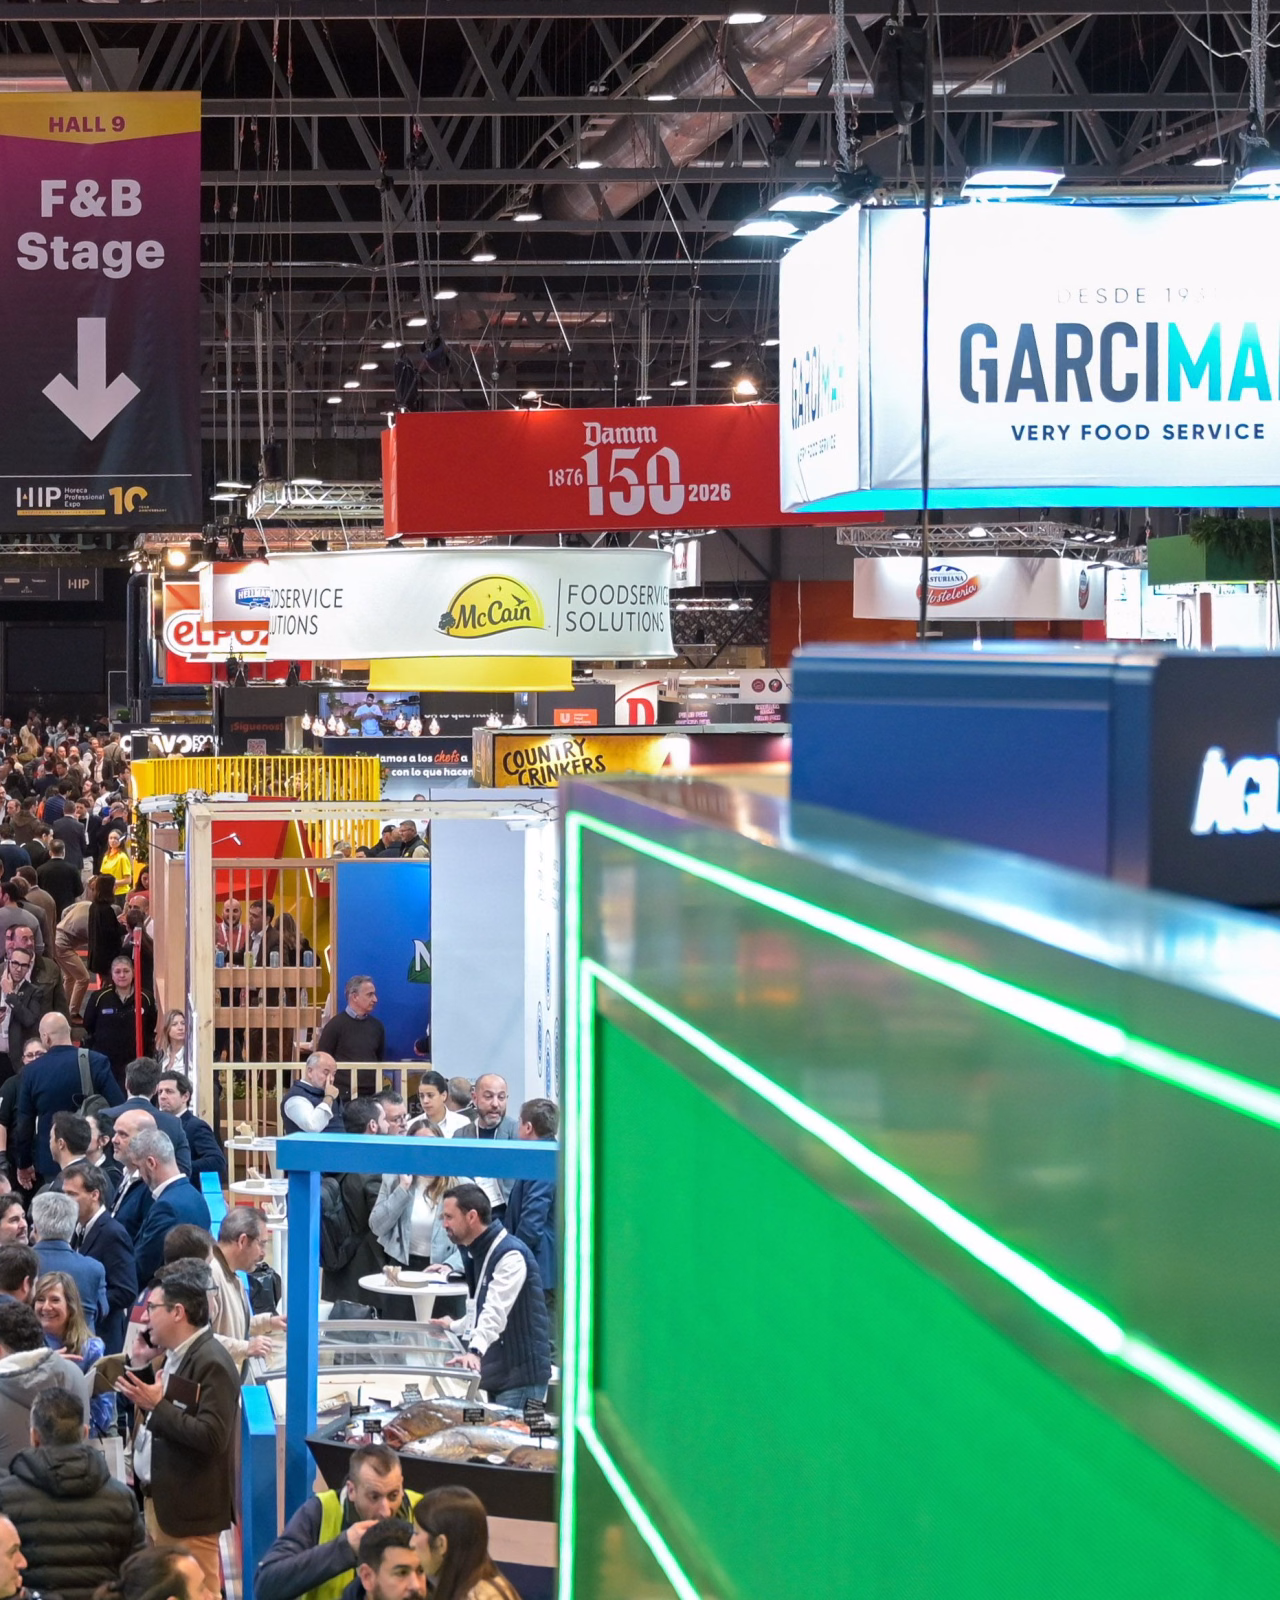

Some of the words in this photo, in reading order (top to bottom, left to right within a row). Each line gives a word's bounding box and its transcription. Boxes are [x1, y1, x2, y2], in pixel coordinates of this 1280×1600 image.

[48, 116, 106, 133] HALL
[111, 116, 126, 132] 9
[40, 179, 142, 218] F&B
[17, 232, 165, 279] Stage
[1057, 287, 1147, 304] DESDE
[1165, 287, 1219, 303] 19
[959, 321, 1280, 404] GARCIMA
[582, 421, 658, 447] Damm
[1011, 424, 1071, 441] VERY
[1081, 424, 1150, 441] FOOD
[1163, 423, 1265, 440] SERVICE
[548, 468, 583, 487] 1876
[580, 446, 685, 516] 150
[688, 483, 731, 502] 2026
[16, 487, 61, 508] HIP
[567, 584, 669, 607] FOODSERVICE
[270, 614, 318, 635] UTIONS
[454, 600, 531, 630] McCain
[565, 611, 665, 632] SOLUTIONS
[418, 753, 433, 763] los
[434, 749, 460, 764] chefs
[460, 755, 469, 763] a
[503, 738, 586, 776] COUNTRY
[391, 769, 410, 777] con
[411, 767, 422, 777] lo
[423, 769, 443, 779] que
[518, 754, 606, 786] CRINKERS
